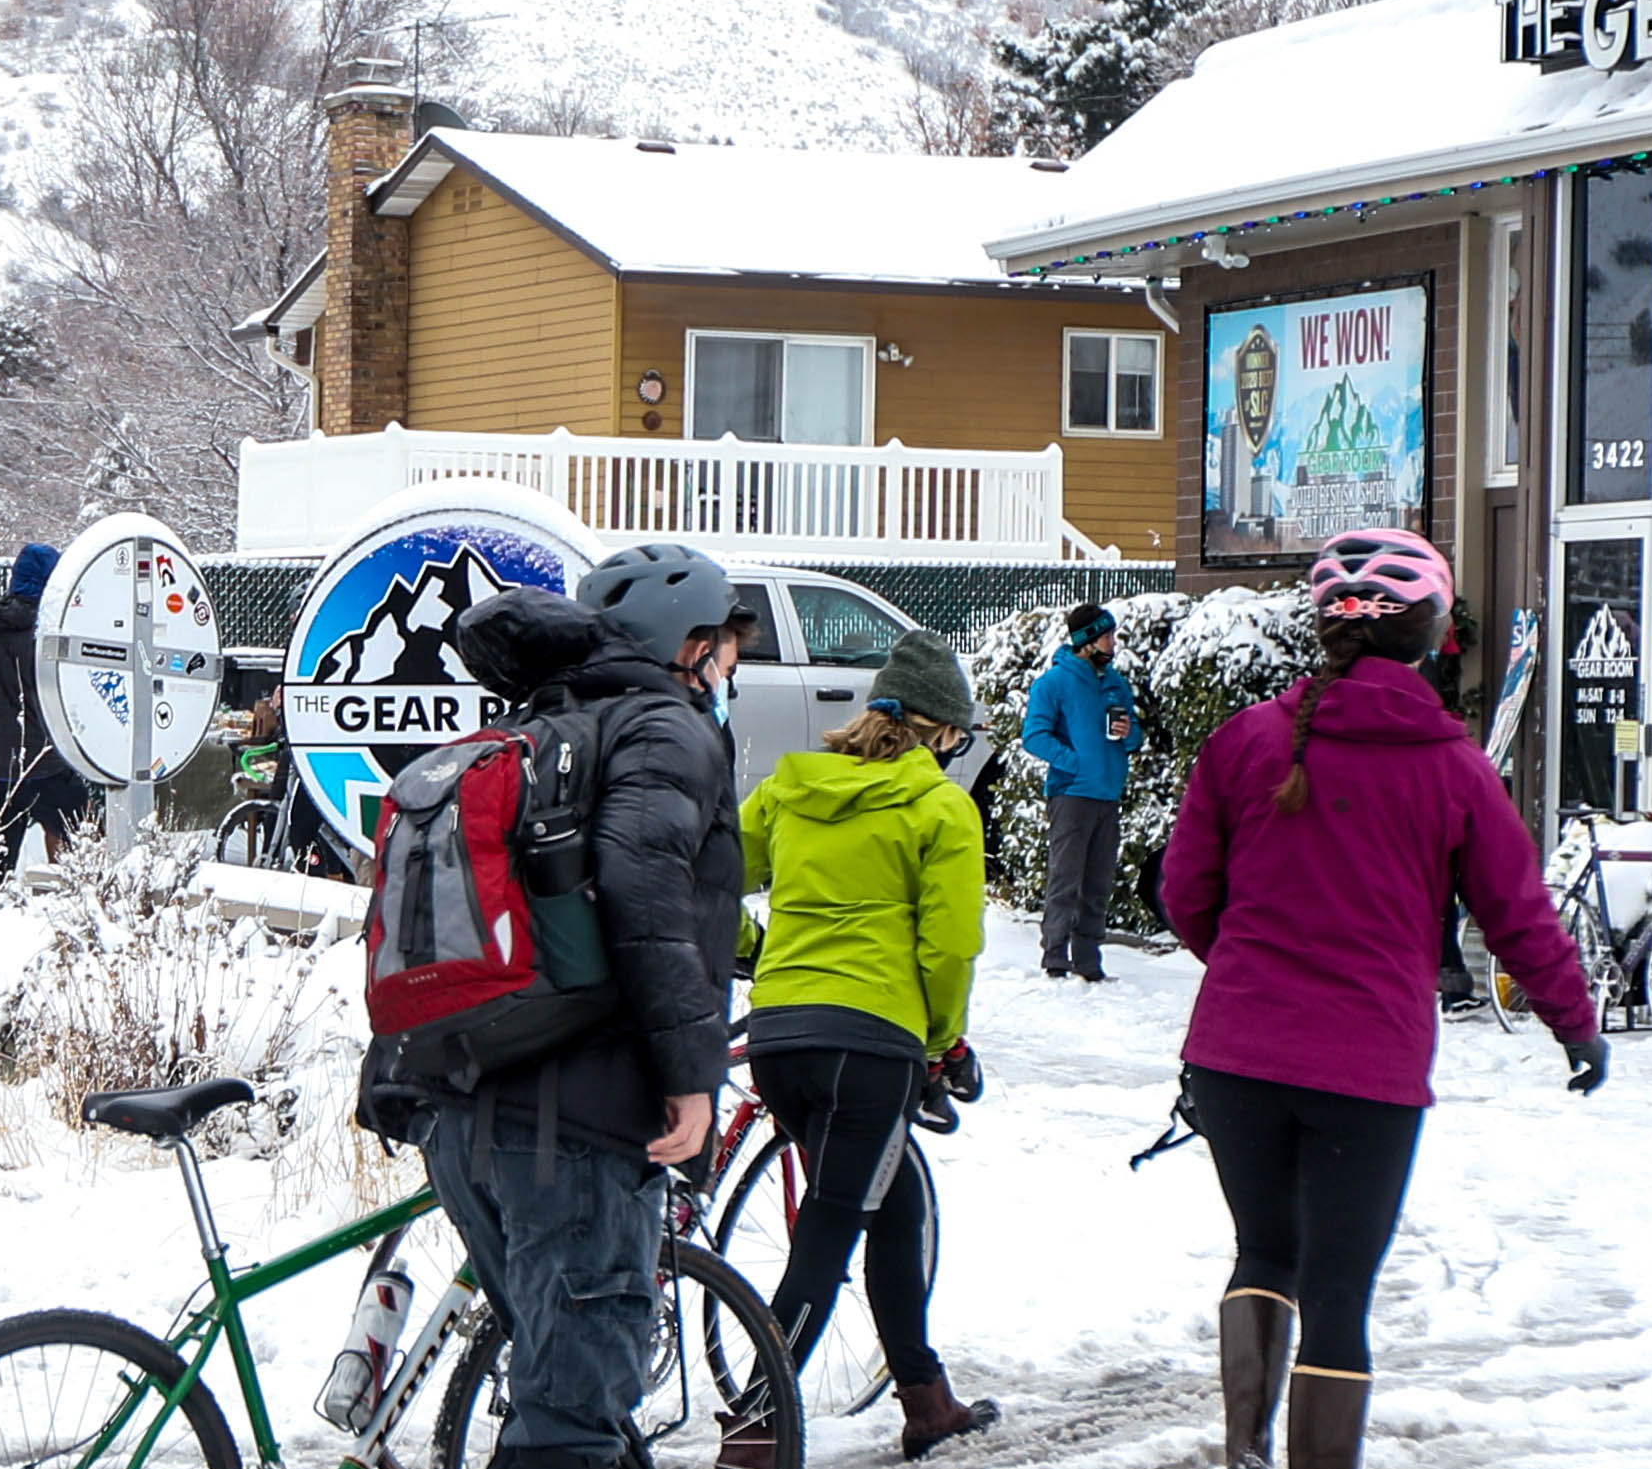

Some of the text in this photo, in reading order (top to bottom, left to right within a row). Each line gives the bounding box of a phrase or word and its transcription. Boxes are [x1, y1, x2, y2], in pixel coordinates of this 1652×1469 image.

[1301, 306, 1391, 369] WE WON!
[1307, 450, 1385, 474] GEAR ROOM
[1593, 440, 1644, 469] 3422
[1360, 481, 1385, 505] SHOP
[1577, 660, 1602, 679] GEAR
[1603, 659, 1634, 678] ROOM
[294, 695, 330, 713] THE
[334, 695, 460, 733] GEAR
[1576, 708, 1596, 724] SUN
